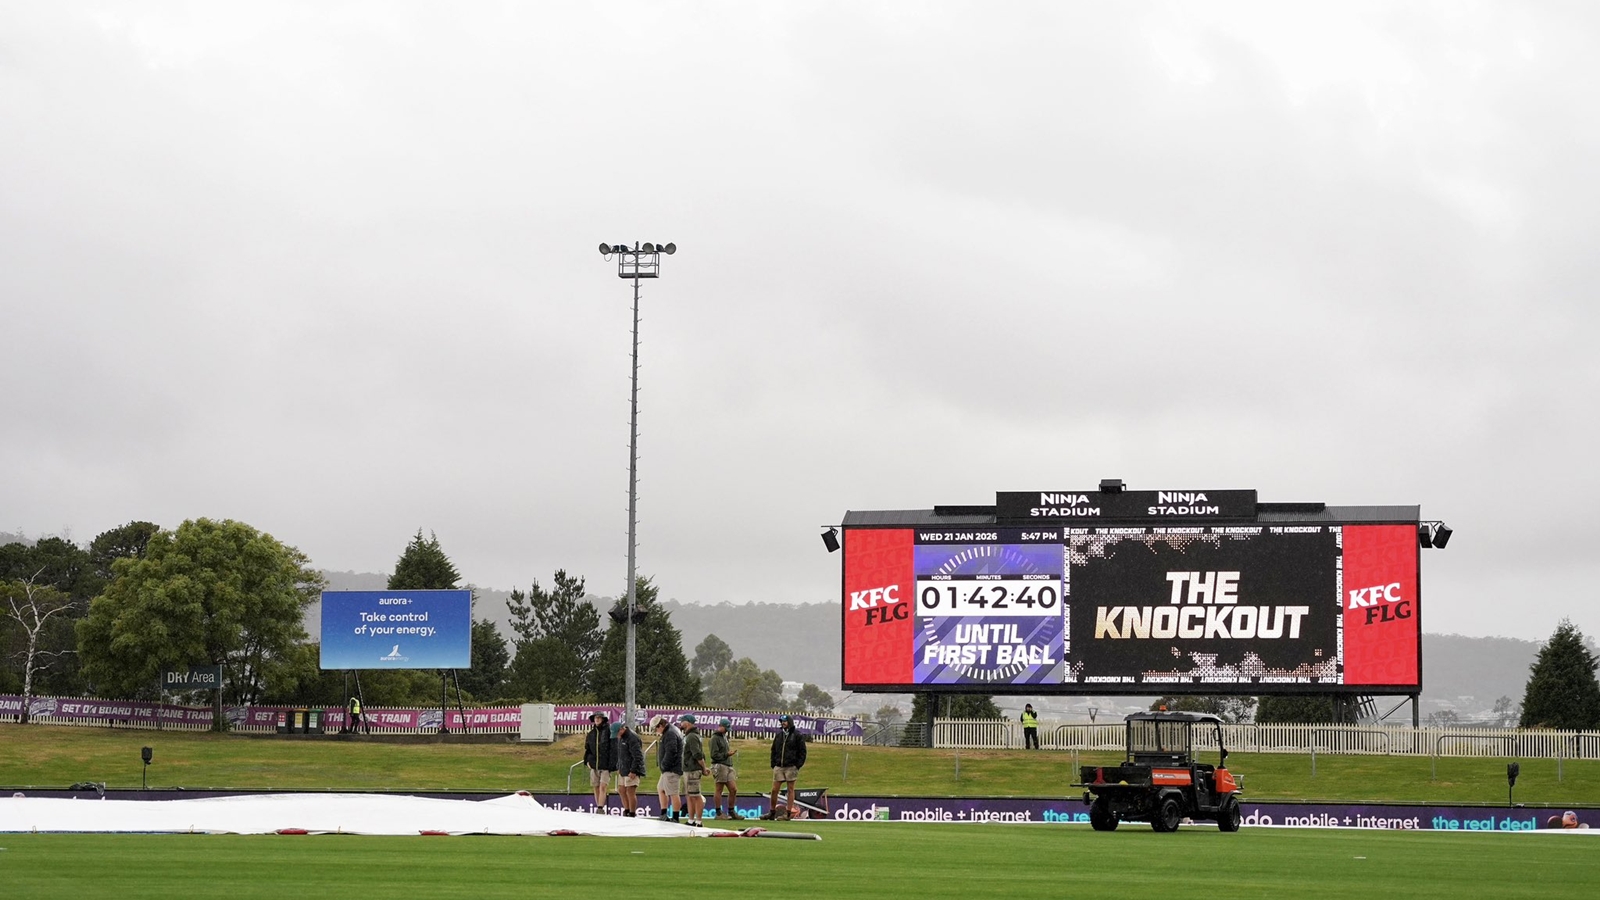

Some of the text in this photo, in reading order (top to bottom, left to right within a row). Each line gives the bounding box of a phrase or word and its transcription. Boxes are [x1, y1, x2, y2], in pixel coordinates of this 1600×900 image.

[1040, 493, 1090, 507] NINJA
[1158, 491, 1208, 505] NINJA
[1030, 508, 1100, 516] STADIUM
[1148, 506, 1219, 515] STADIUM
[920, 533, 942, 541] WED
[1166, 571, 1240, 604] THE
[850, 585, 899, 610] KFC
[921, 586, 1057, 609] 01:42:40
[1348, 582, 1401, 609] KFC
[360, 612, 428, 622] Take control
[865, 603, 909, 626] FLG
[1364, 601, 1411, 625] FLG
[1095, 606, 1309, 639] KNOCKOUT
[354, 625, 436, 637] of your energy.
[955, 624, 1023, 644] UNTIL
[924, 645, 1055, 665] FIRST BALL
[167, 672, 215, 683] DRY Area
[62, 704, 81, 713] GET
[82, 705, 97, 714] ON
[98, 706, 131, 715] BOARD
[134, 708, 152, 716] THE
[186, 711, 214, 720] TRAIN
[255, 712, 274, 720] GET
[381, 714, 411, 723] TRAIN
[474, 714, 488, 723] ON
[731, 717, 750, 727] THE
[901, 808, 1031, 821] mobile + internet
[1043, 809, 1069, 822] the
[1285, 813, 1419, 829] mobile + internet
[1432, 816, 1536, 831] the real deal
